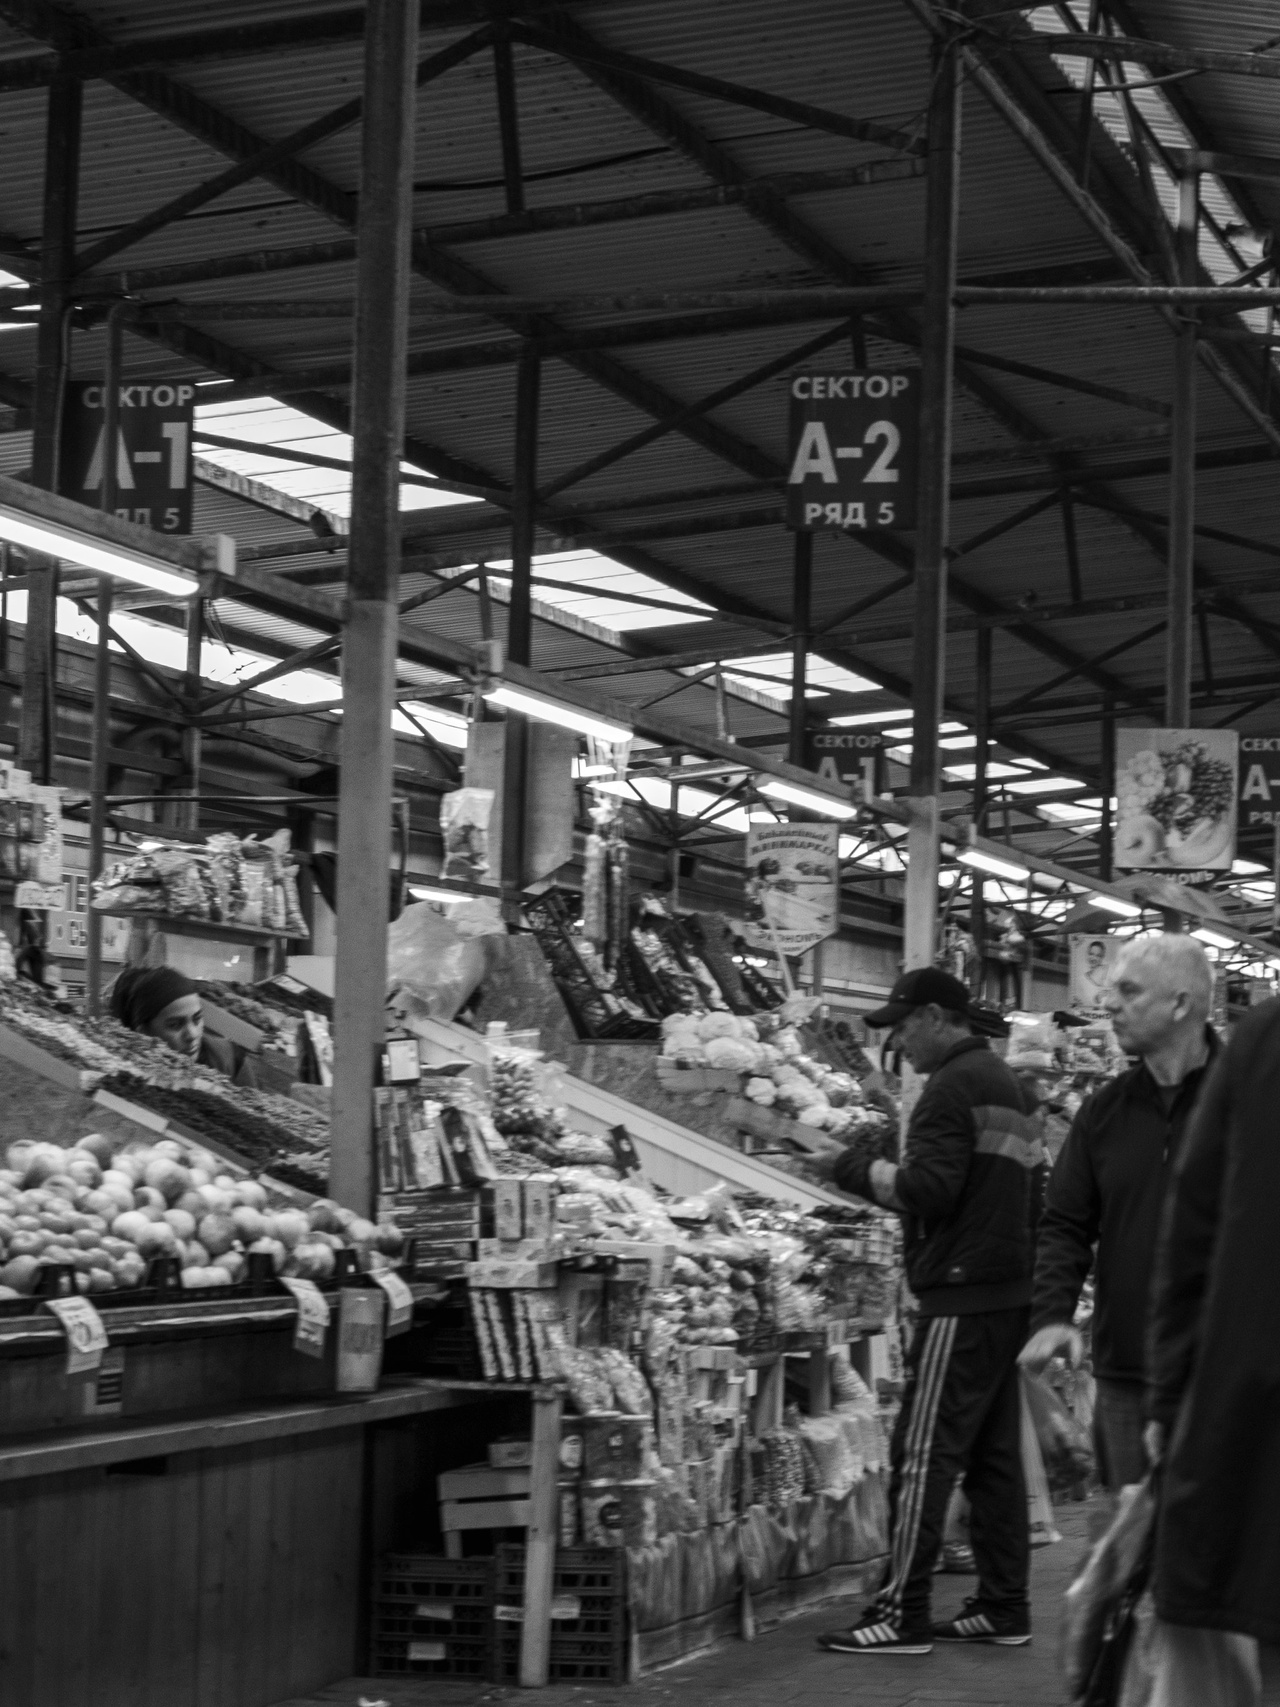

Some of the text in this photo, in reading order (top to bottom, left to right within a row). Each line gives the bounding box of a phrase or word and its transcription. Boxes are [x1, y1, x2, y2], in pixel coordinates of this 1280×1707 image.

[792, 375, 909, 399] СЕКТОР
[788, 420, 901, 484] А-2
[163, 508, 180, 529] 5
[804, 502, 895, 528] РЯД 5
[813, 734, 881, 748] СЕКТОР
